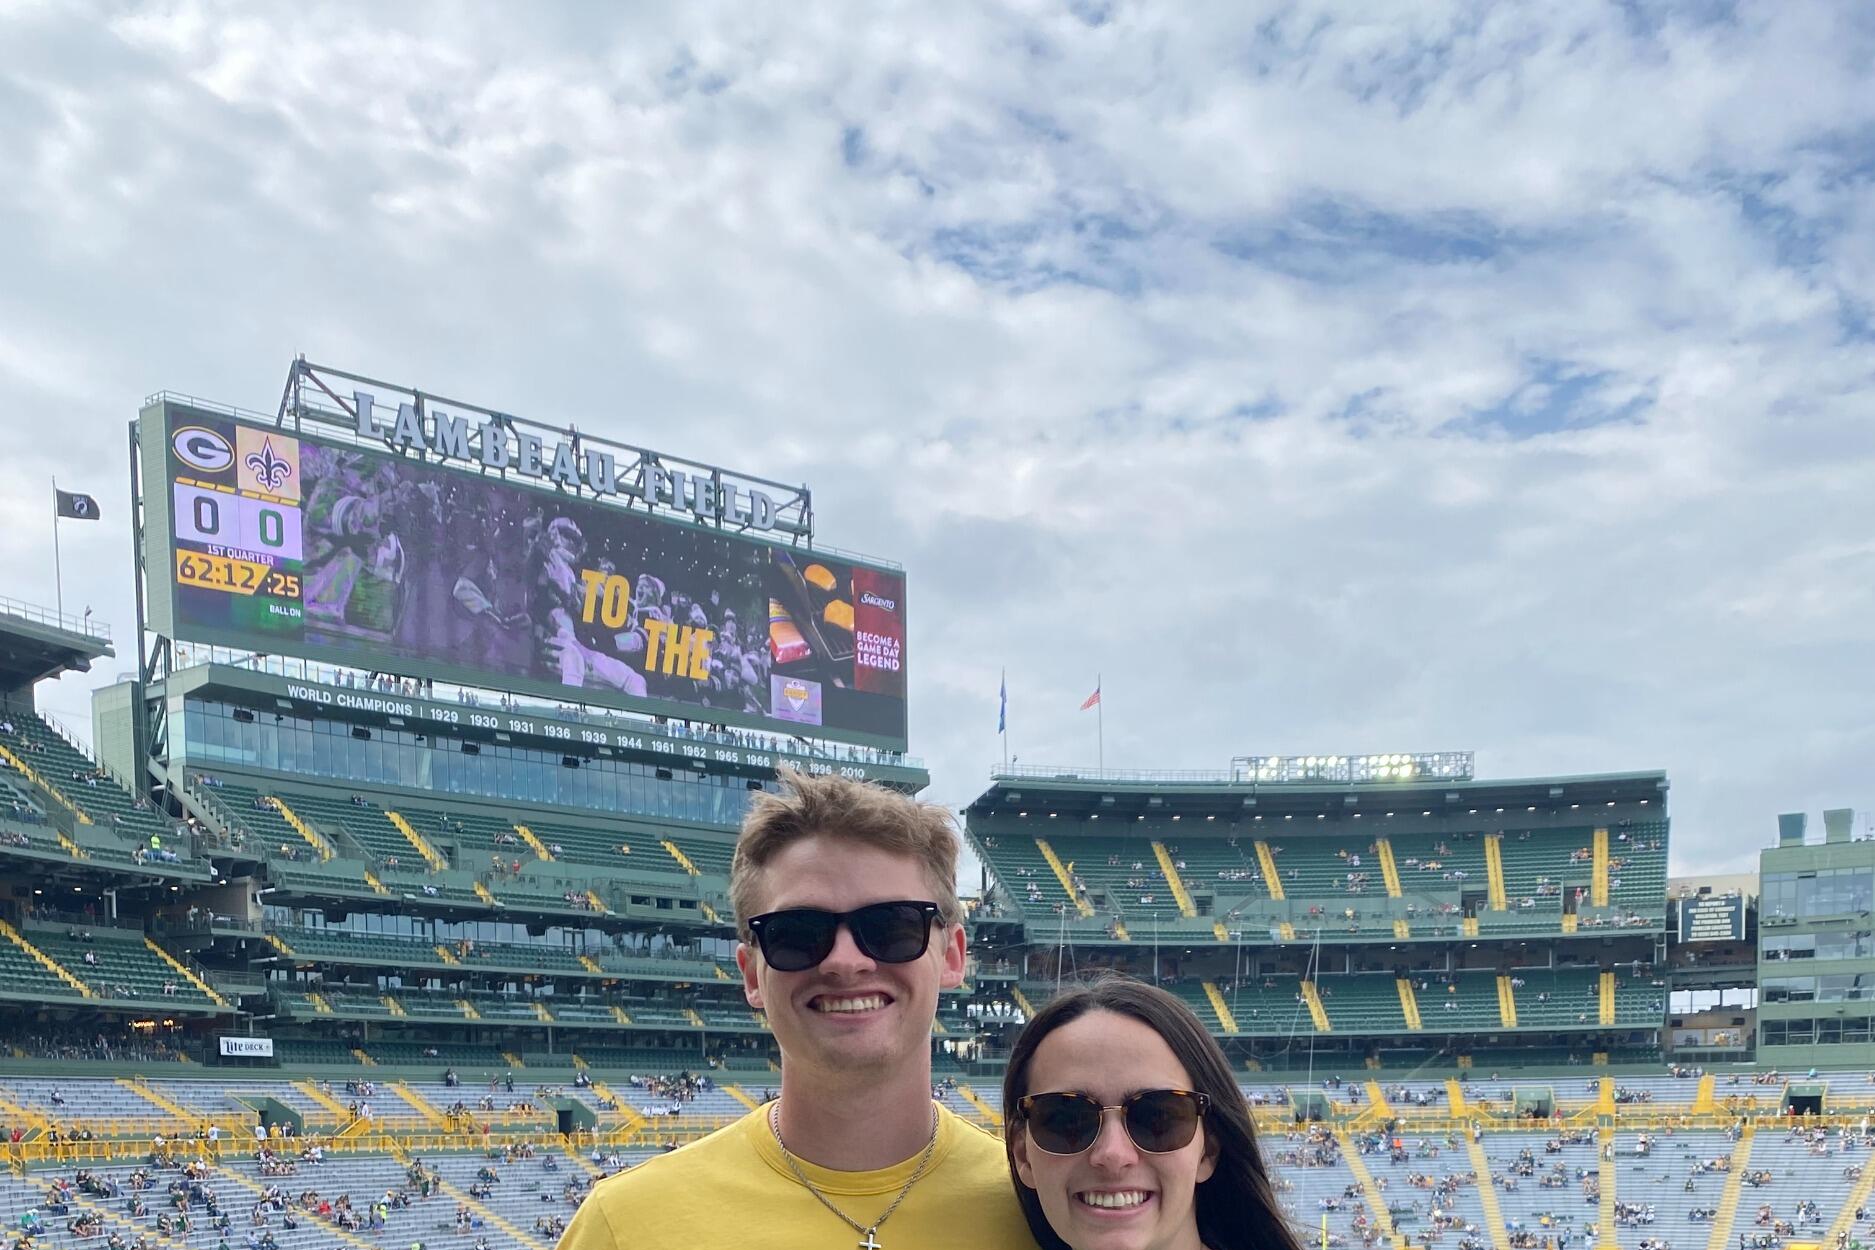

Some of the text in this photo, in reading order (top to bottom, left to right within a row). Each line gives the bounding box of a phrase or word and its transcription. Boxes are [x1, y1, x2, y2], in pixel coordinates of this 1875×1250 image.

[353, 390, 776, 531] LAMBEAU FIELD
[194, 496, 219, 535] 0
[259, 509, 283, 547] 0
[207, 544, 274, 566] 1ST QUARTER
[180, 556, 300, 597] 62:12 :25
[269, 605, 301, 618] BALL ON
[581, 569, 630, 628] TO
[861, 592, 895, 610] SARGENTO
[644, 618, 714, 681] THE
[857, 631, 900, 649] BECOME A
[857, 641, 900, 658] GAME DAY
[858, 652, 900, 671] LEGEND
[287, 684, 331, 705] WORLD
[336, 693, 413, 716] CHAMPIONS
[430, 708, 459, 723] 1929
[469, 713, 498, 728] 1930
[508, 719, 534, 735] 1931
[543, 724, 571, 739] 1936
[580, 729, 607, 744] 1939
[616, 735, 642, 750] 1944
[651, 740, 675, 754] 1961
[682, 745, 706, 759] 1962
[714, 749, 739, 763] 1965
[746, 754, 770, 767] 1966
[840, 766, 865, 779] 2010
[245, 1043, 264, 1051] DECK
